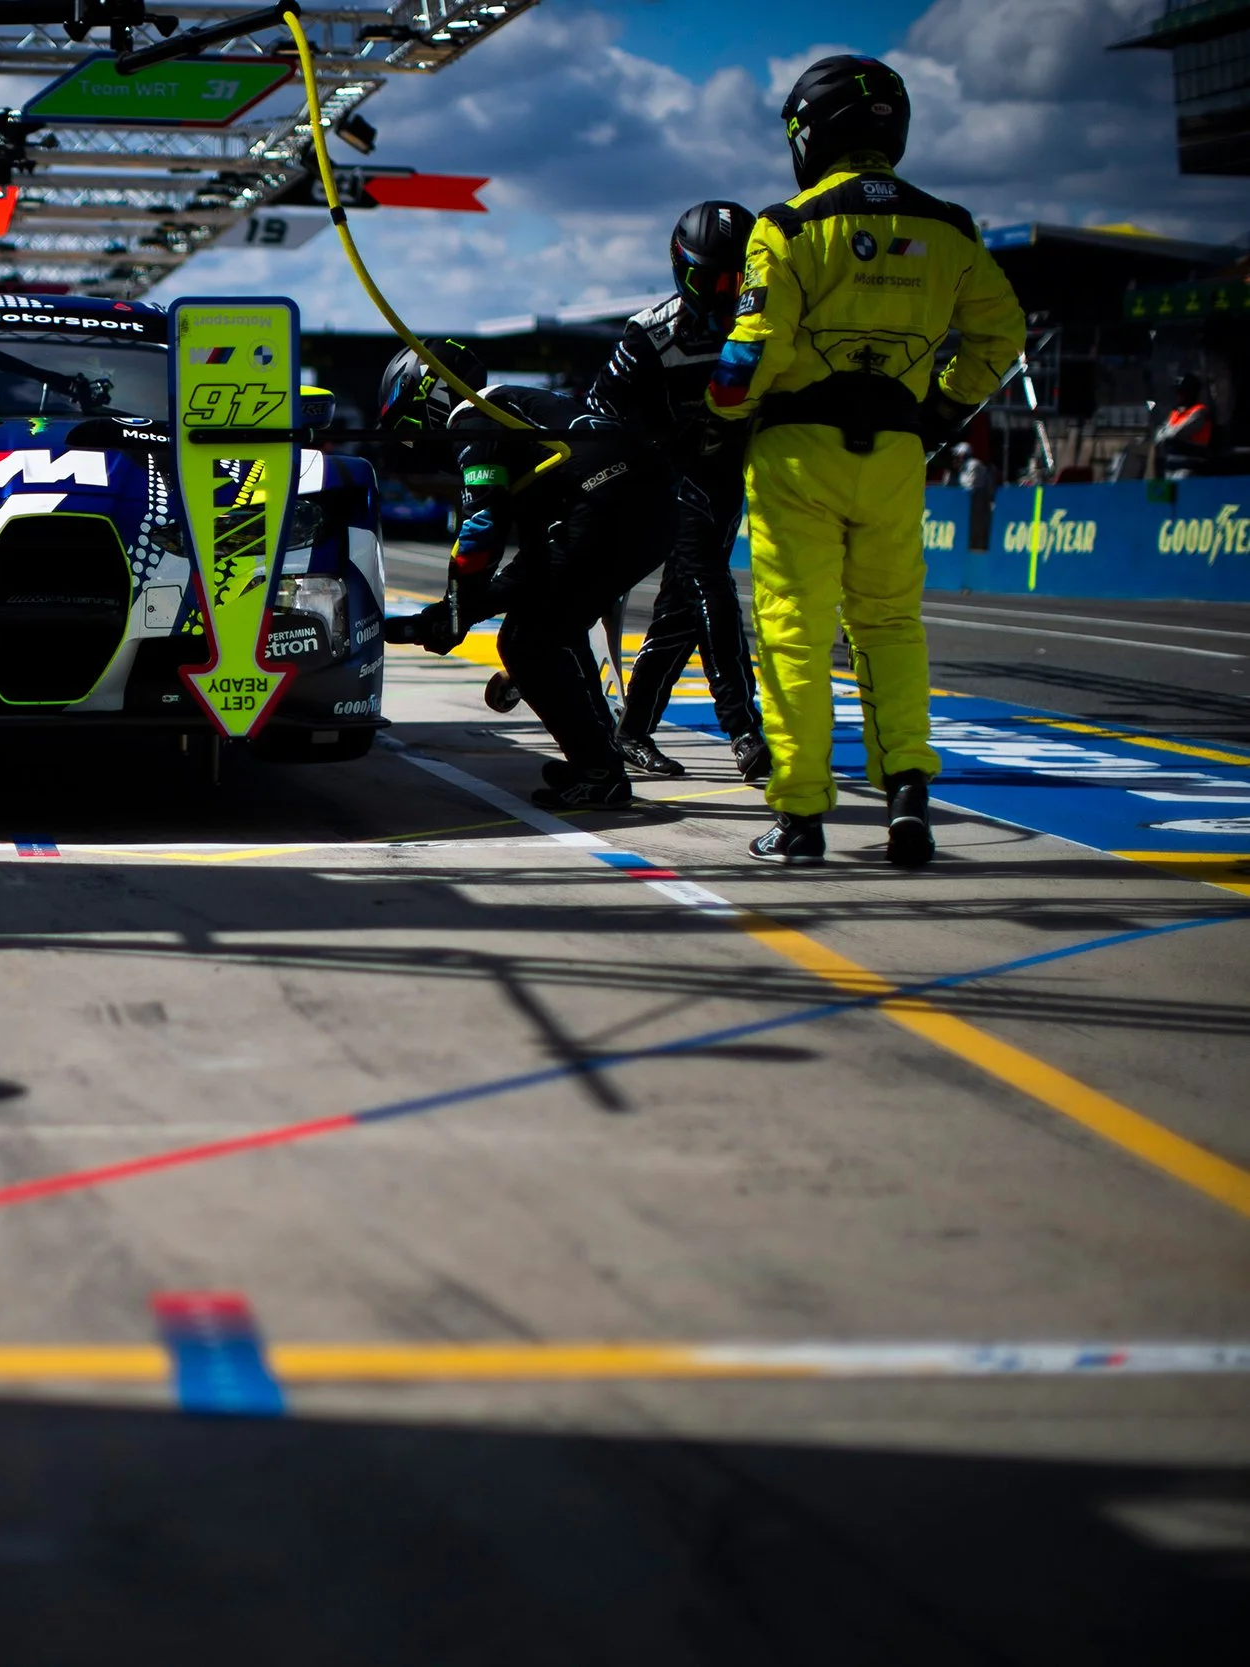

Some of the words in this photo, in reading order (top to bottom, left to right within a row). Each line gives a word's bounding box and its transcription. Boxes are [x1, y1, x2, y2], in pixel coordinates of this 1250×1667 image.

[80, 81, 129, 98] Team
[136, 81, 179, 98] WRT
[201, 79, 239, 99] 31
[863, 184, 897, 196] OMP
[245, 217, 287, 244] 19
[853, 271, 922, 288] Motorsport
[193, 315, 273, 329] Motorsport
[183, 383, 287, 427] 46
[581, 462, 628, 491] sparco
[1003, 508, 1097, 563] GOODYEAR
[1157, 503, 1250, 567] GOODYE
[267, 627, 316, 644] PERTAMINA
[208, 677, 268, 693] READY
[221, 696, 255, 711] GET
